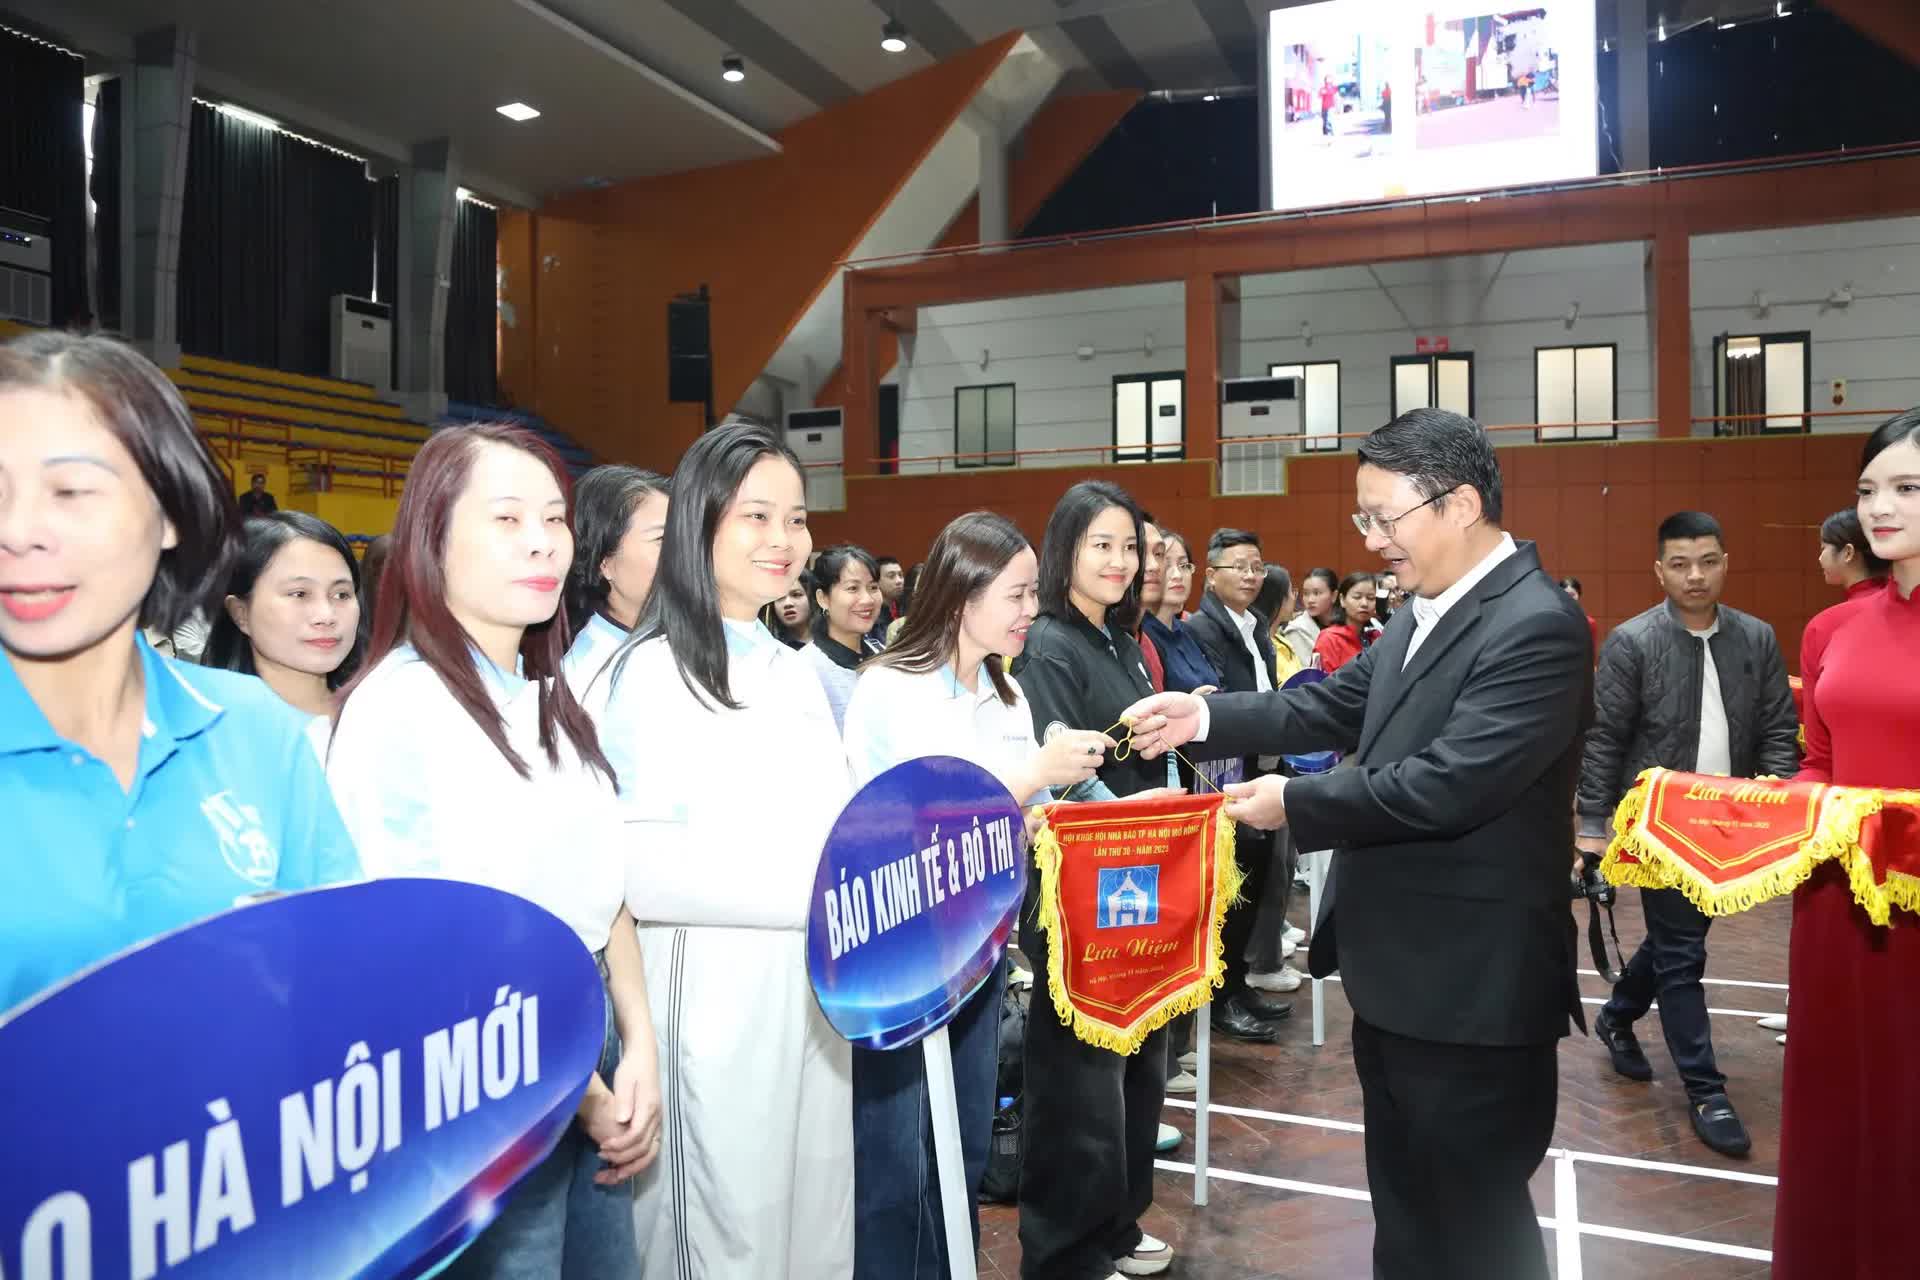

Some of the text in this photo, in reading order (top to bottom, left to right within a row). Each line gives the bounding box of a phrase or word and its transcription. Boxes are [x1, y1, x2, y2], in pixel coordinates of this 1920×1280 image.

[824, 815, 1015, 961] BÁO KINH TẾ & ĐÔ THỊ
[1126, 937, 1179, 958] Niệm
[128, 1098, 256, 1280] HÀ
[280, 1040, 402, 1208] NỘI
[423, 984, 540, 1133] MỚI
